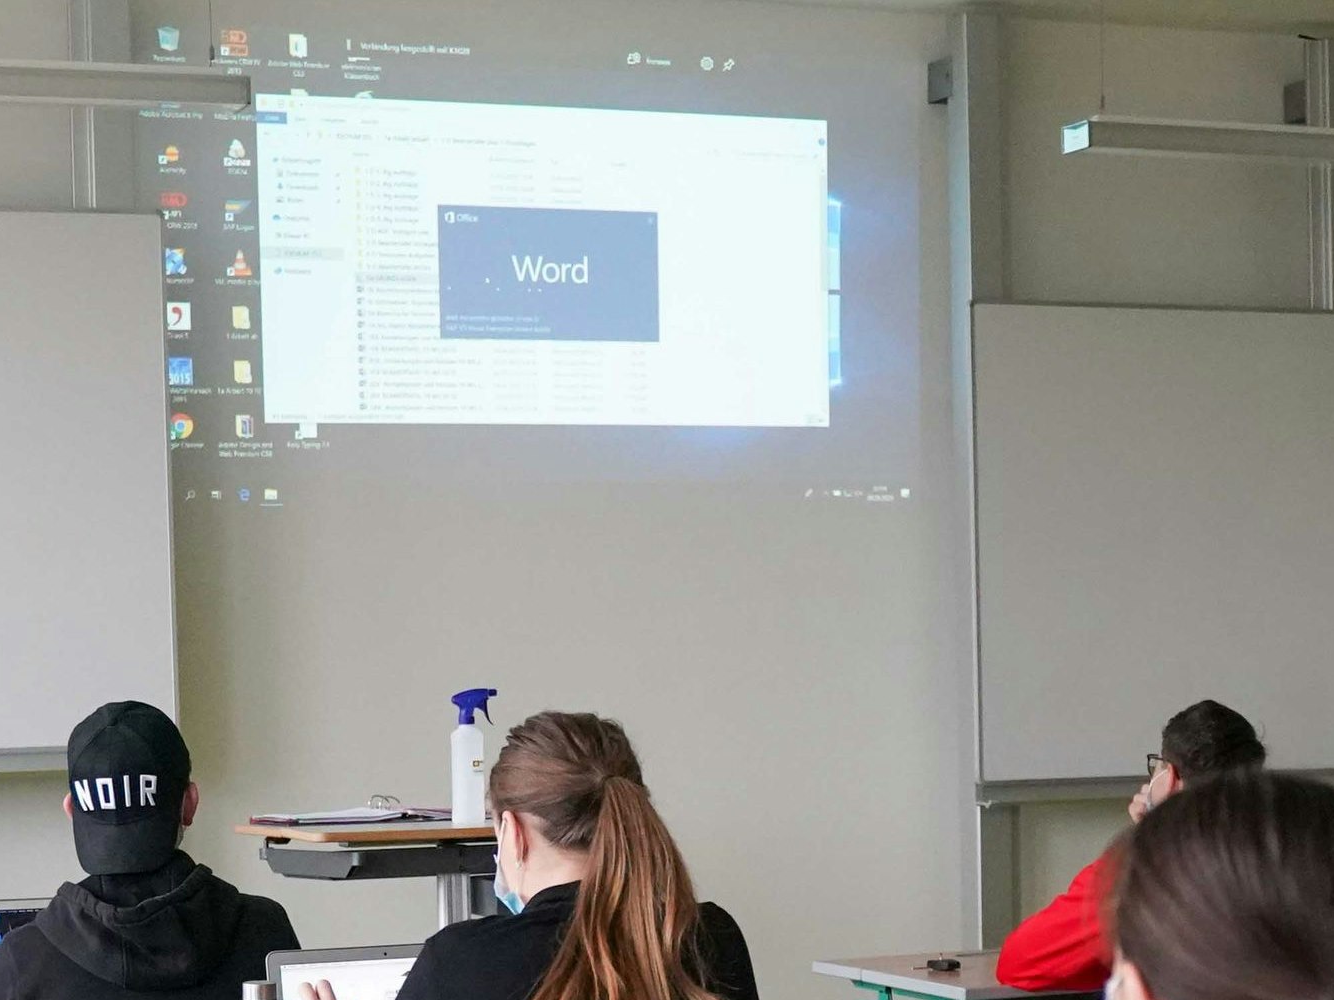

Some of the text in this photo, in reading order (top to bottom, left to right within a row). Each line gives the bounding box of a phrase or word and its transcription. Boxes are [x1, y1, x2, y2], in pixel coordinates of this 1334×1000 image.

[456, 213, 478, 223] Office
[511, 254, 589, 284] Word
[74, 774, 157, 812] NOIR
